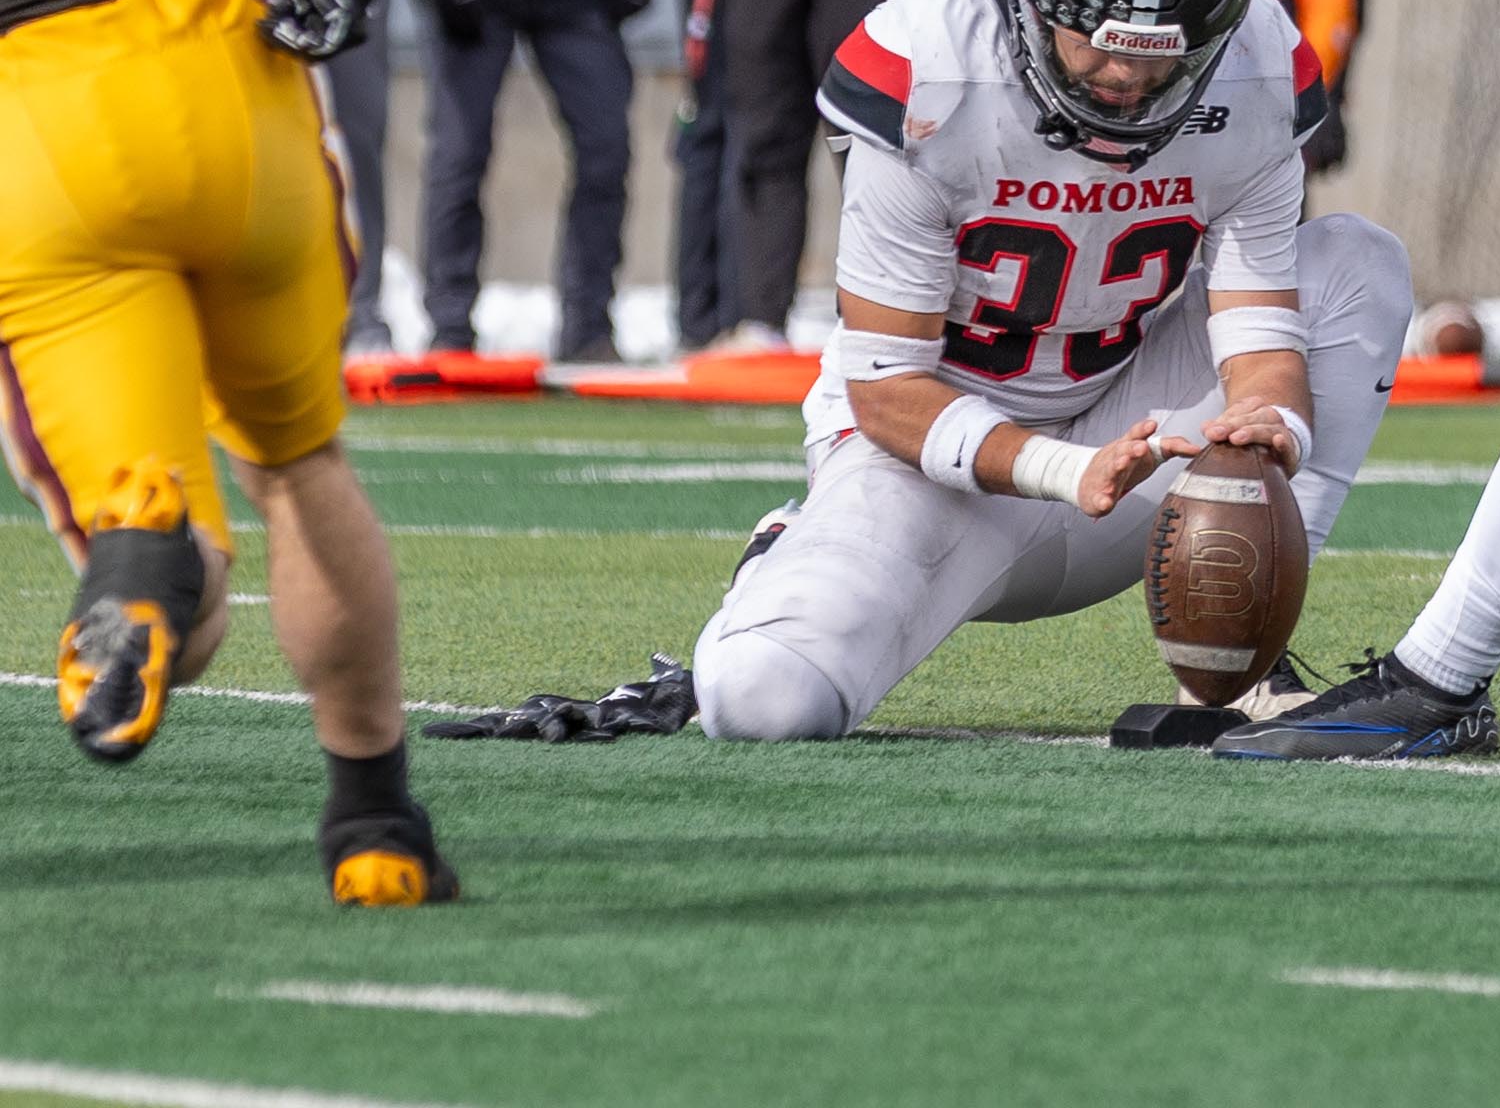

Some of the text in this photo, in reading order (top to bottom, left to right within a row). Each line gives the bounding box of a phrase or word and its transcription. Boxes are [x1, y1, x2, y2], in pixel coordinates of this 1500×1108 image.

[1104, 30, 1180, 50] Riddell
[992, 176, 1195, 213] POMONA
[938, 214, 1205, 383] 33
